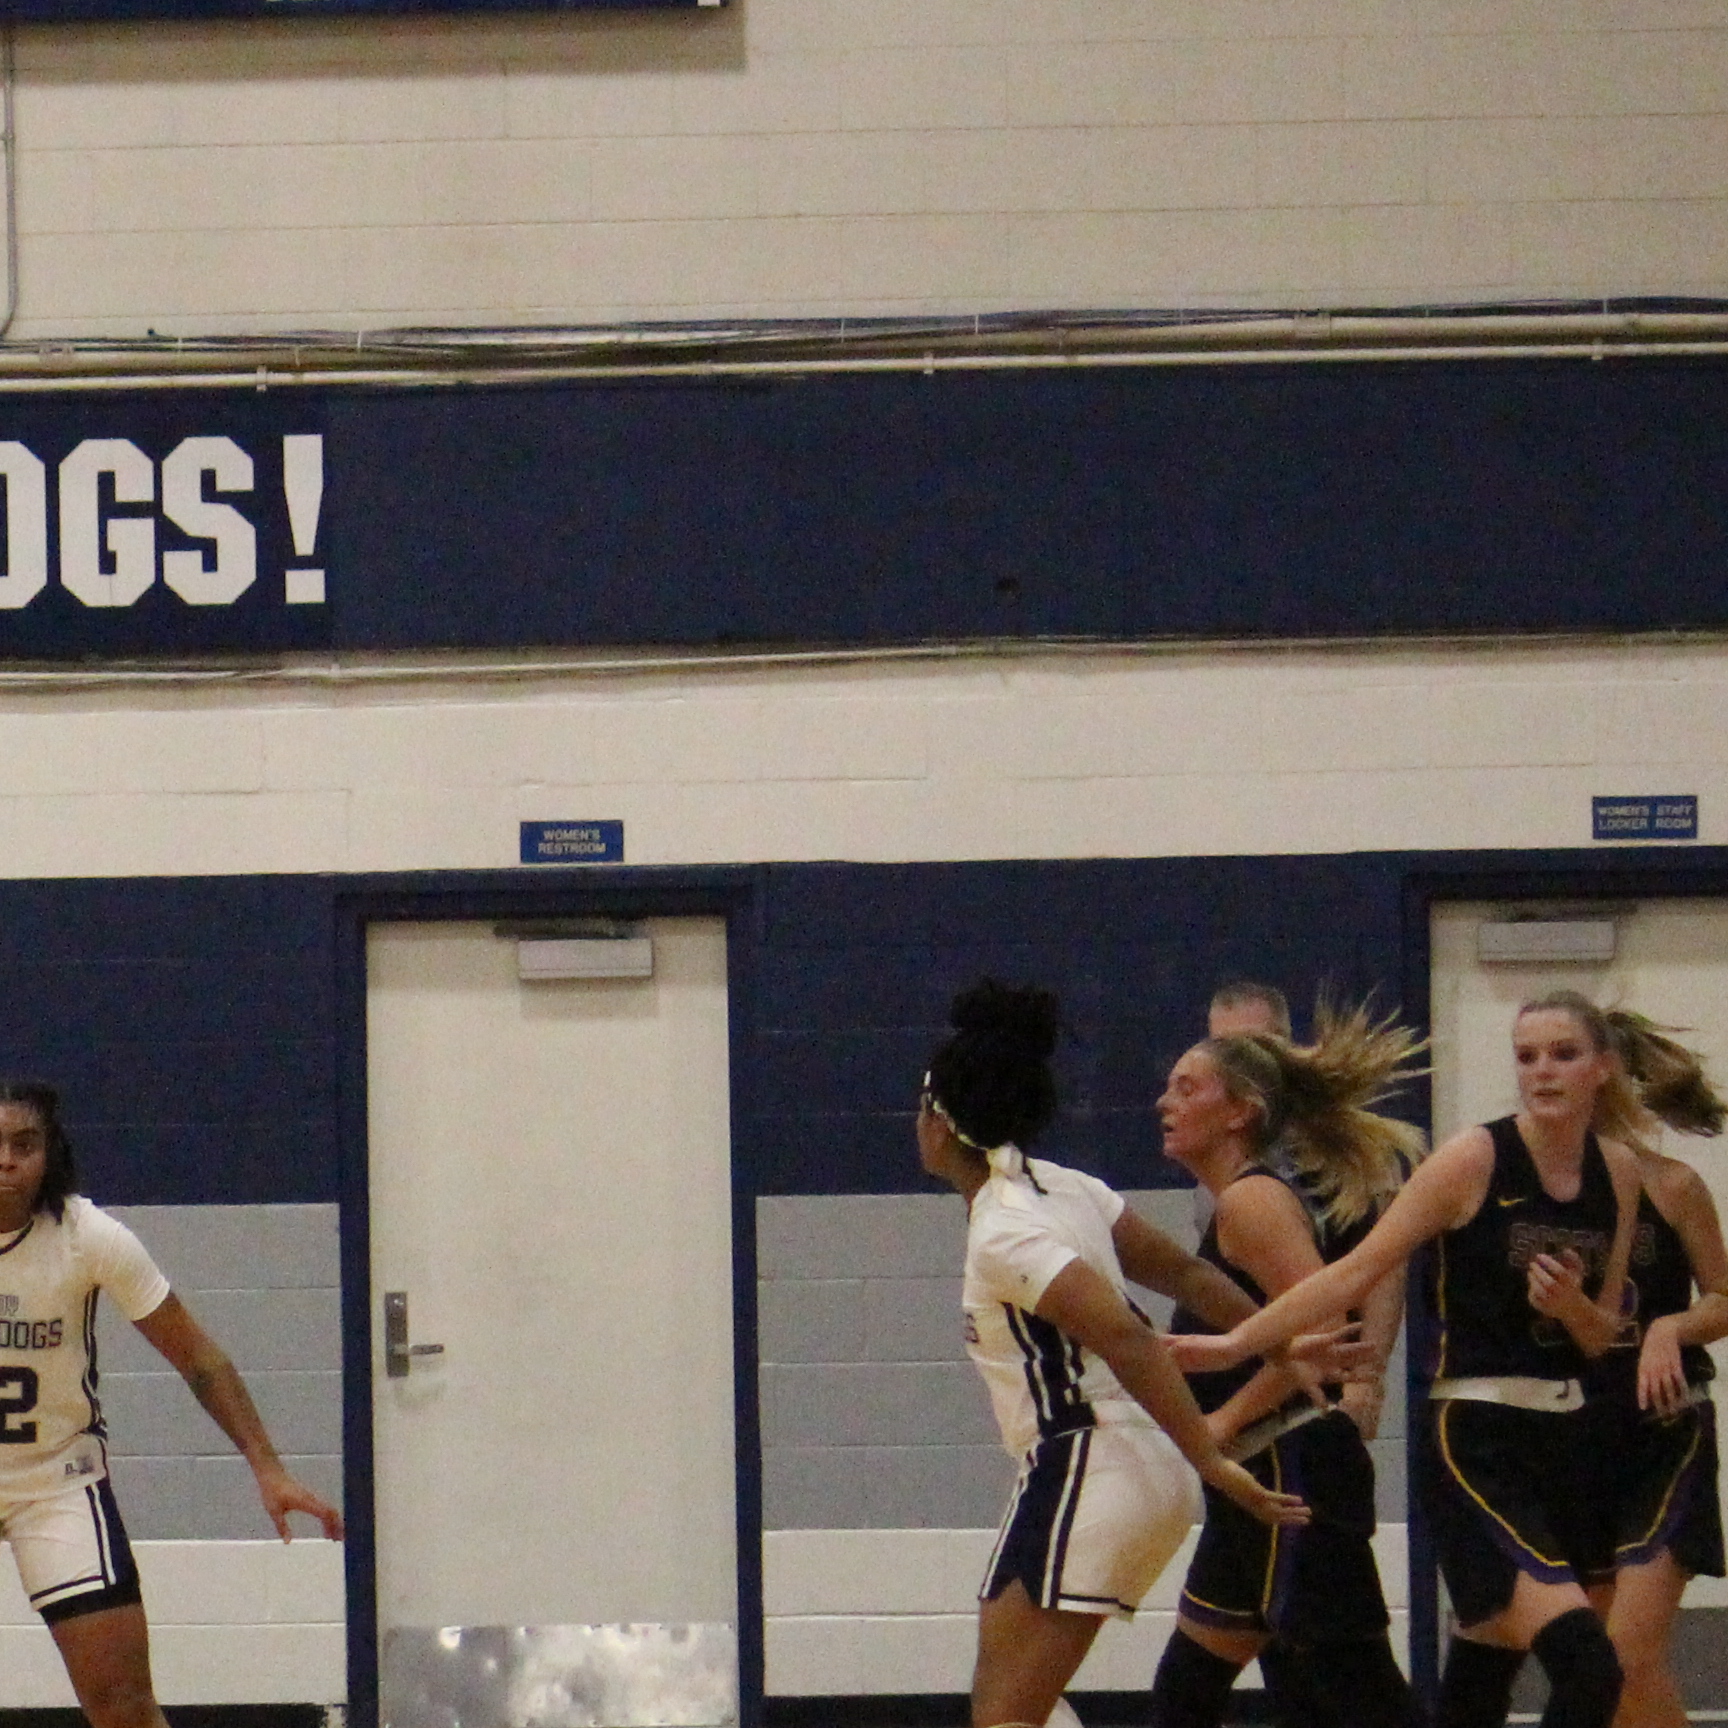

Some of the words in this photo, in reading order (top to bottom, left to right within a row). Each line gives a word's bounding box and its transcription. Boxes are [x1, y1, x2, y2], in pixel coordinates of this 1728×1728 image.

[1655, 817, 1693, 829] ROOM
[543, 829, 601, 841] WOMEN'S
[537, 842, 607, 856] RESTROOM
